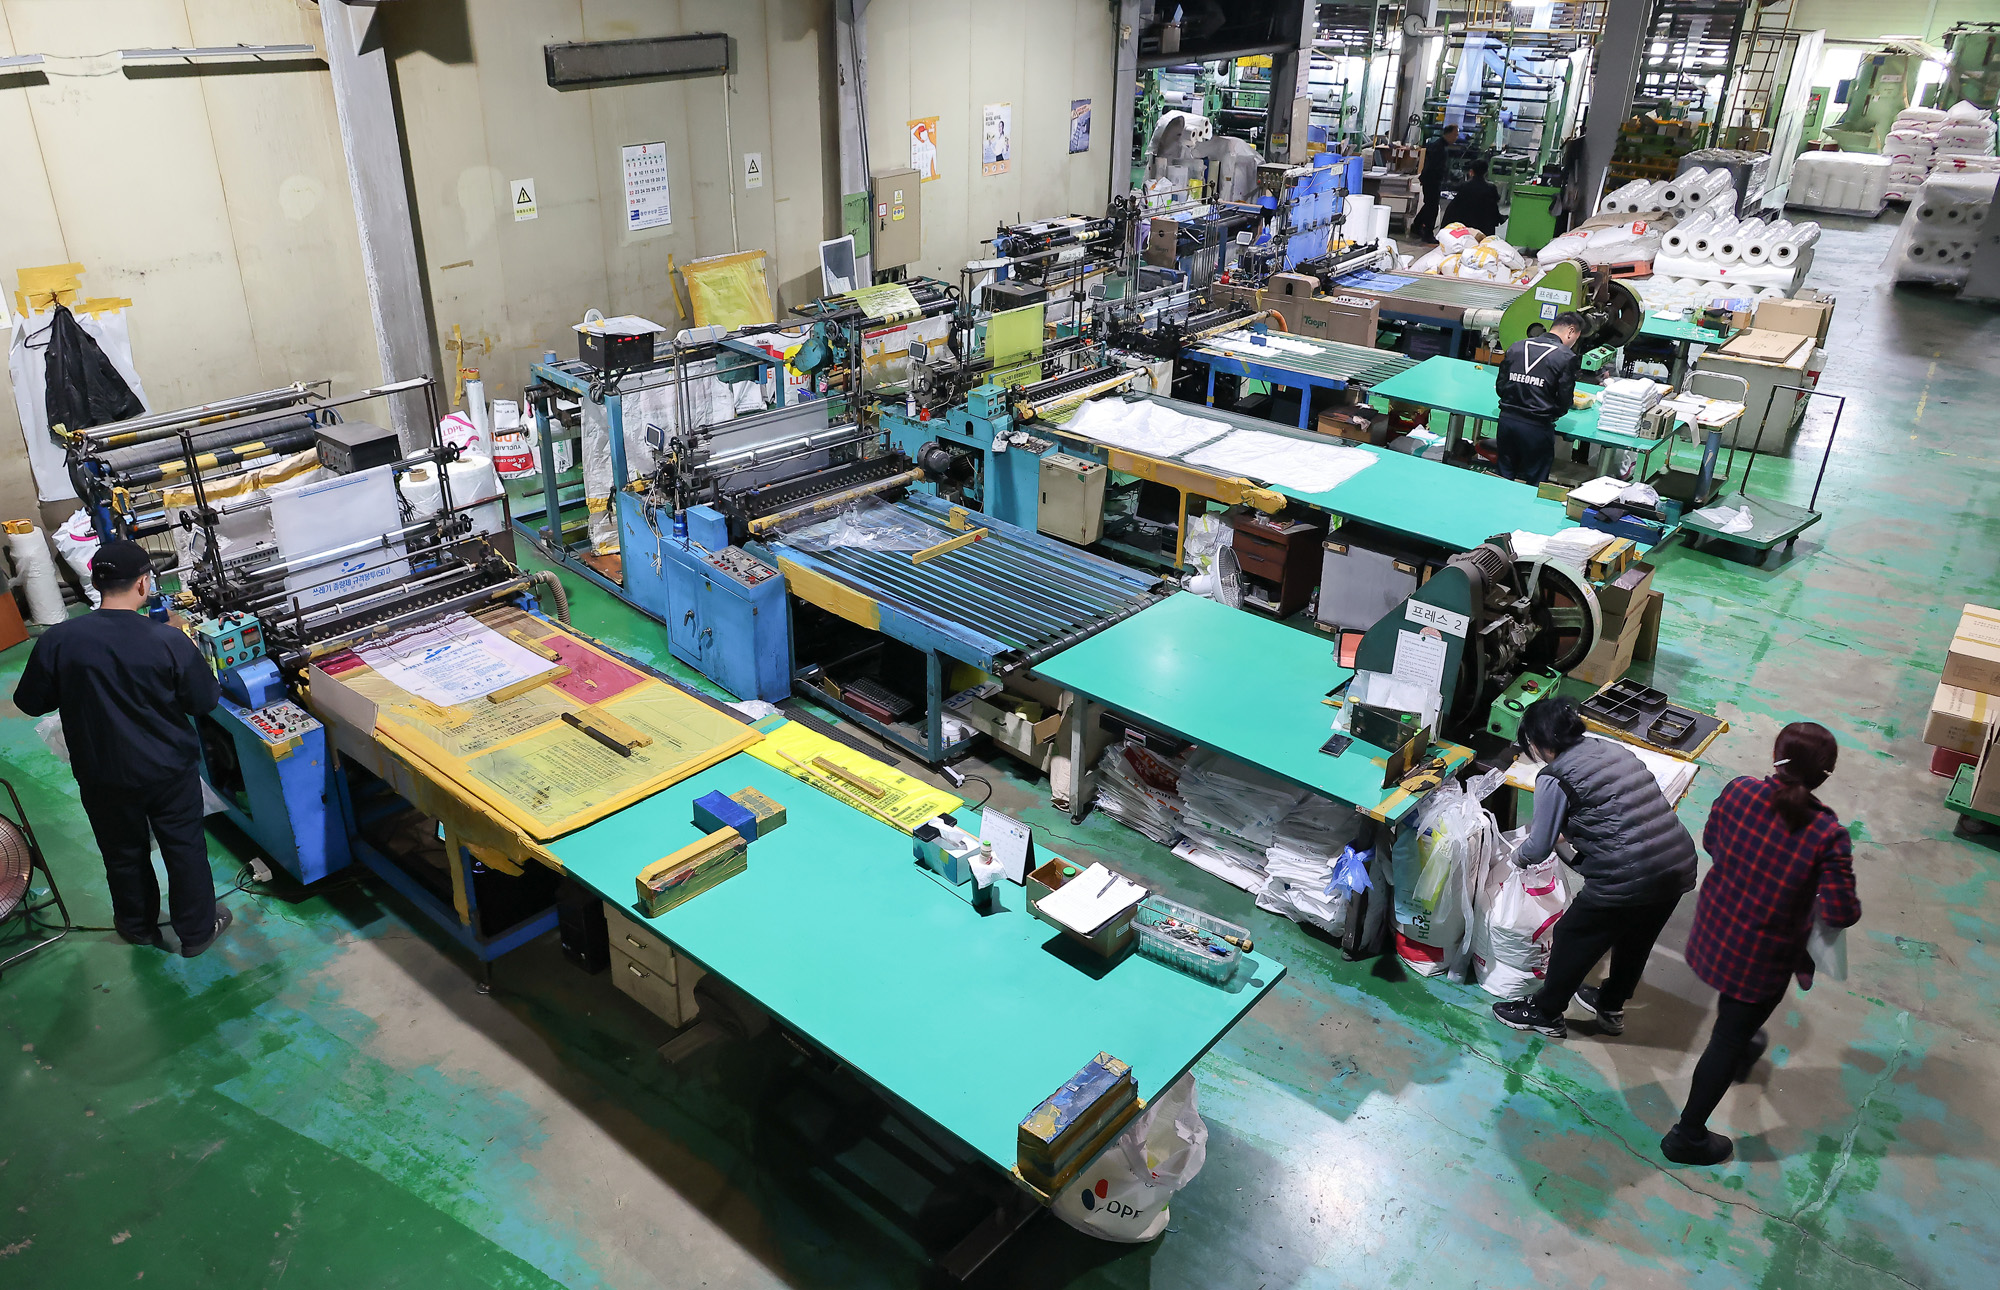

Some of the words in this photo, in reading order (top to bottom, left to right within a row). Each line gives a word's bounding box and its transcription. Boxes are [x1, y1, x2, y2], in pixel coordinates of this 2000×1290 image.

[1539, 291, 1560, 299] 프레스
[442, 425, 464, 437] LDPE
[312, 585, 332, 597] 쓰레기
[1411, 605, 1448, 624] 프레스
[1454, 619, 1462, 631] 2
[946, 684, 986, 707] HDPE
